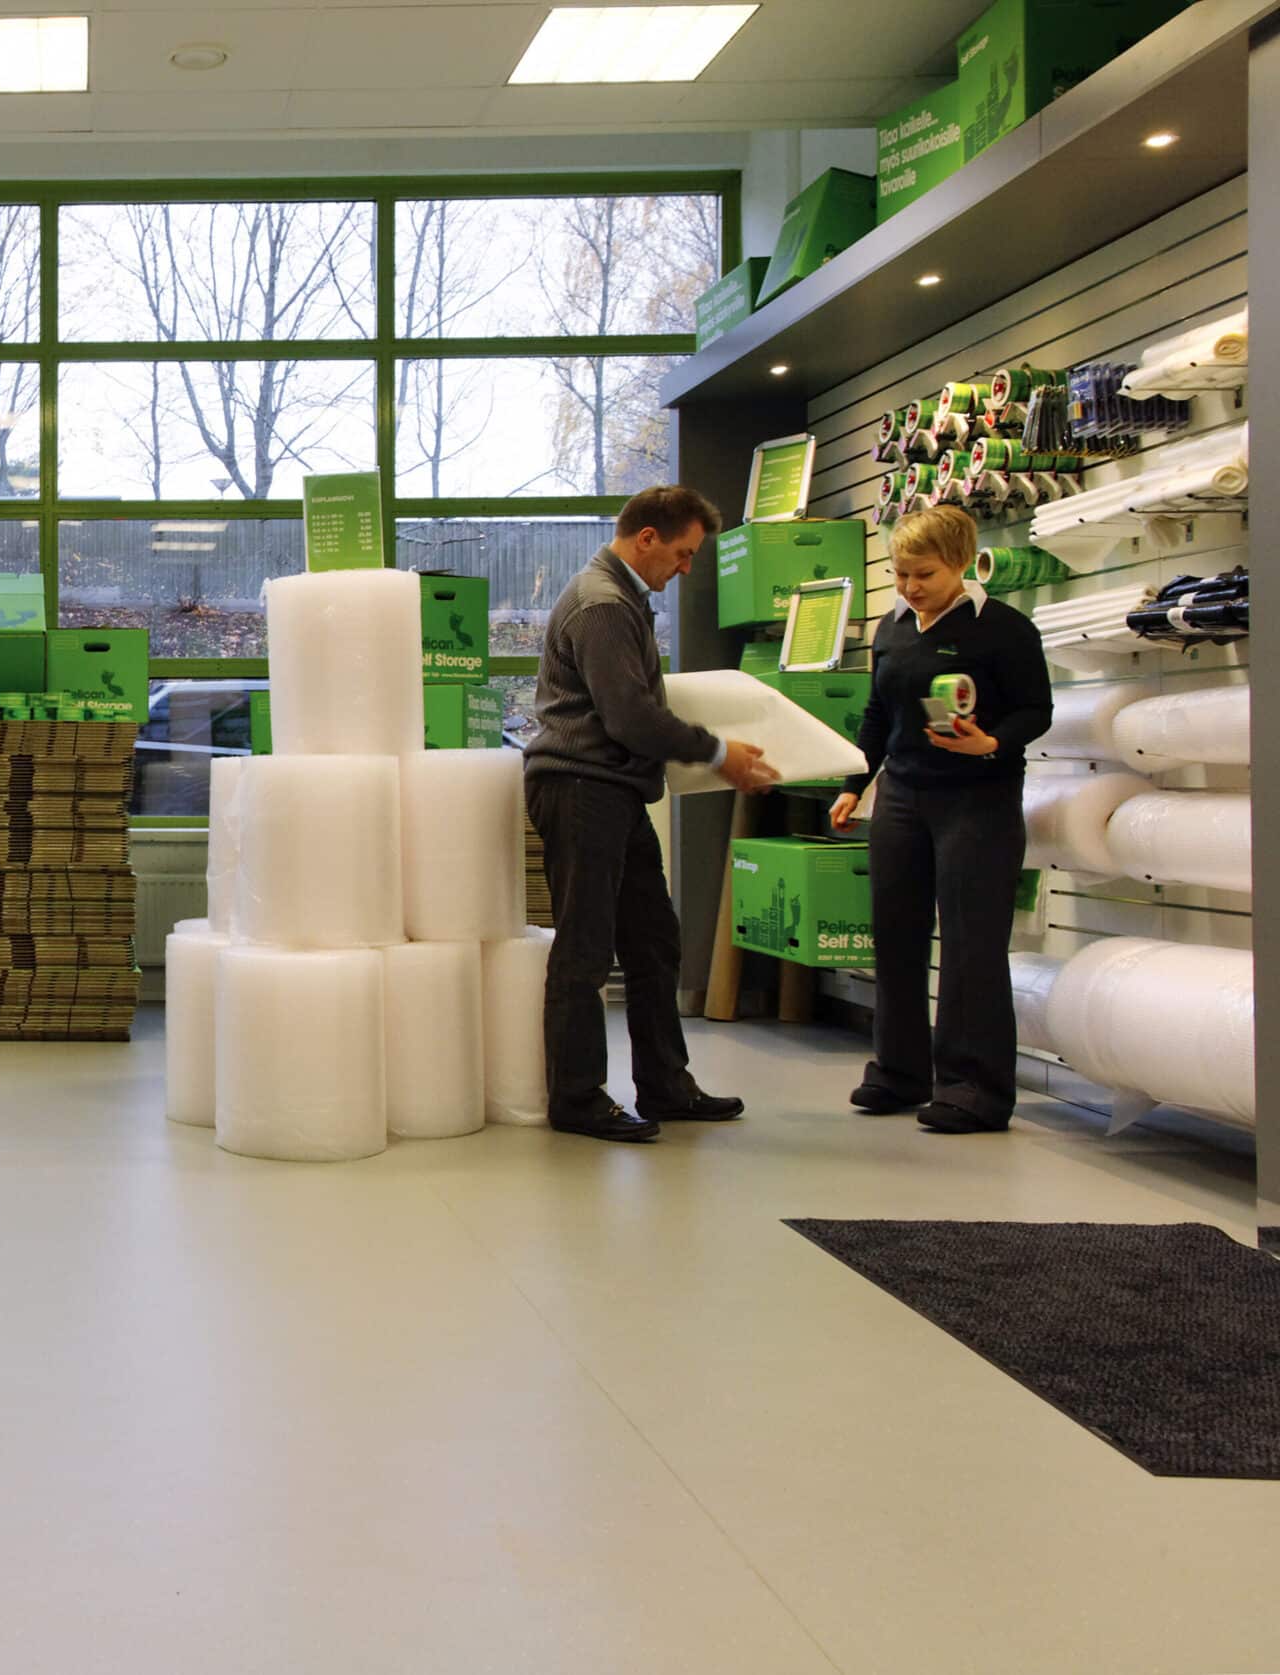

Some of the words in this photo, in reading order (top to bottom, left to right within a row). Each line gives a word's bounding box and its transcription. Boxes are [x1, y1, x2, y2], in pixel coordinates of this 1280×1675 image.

[434, 652, 483, 671] Storage
[817, 920, 871, 935] Pelica
[818, 934, 850, 949] Self
